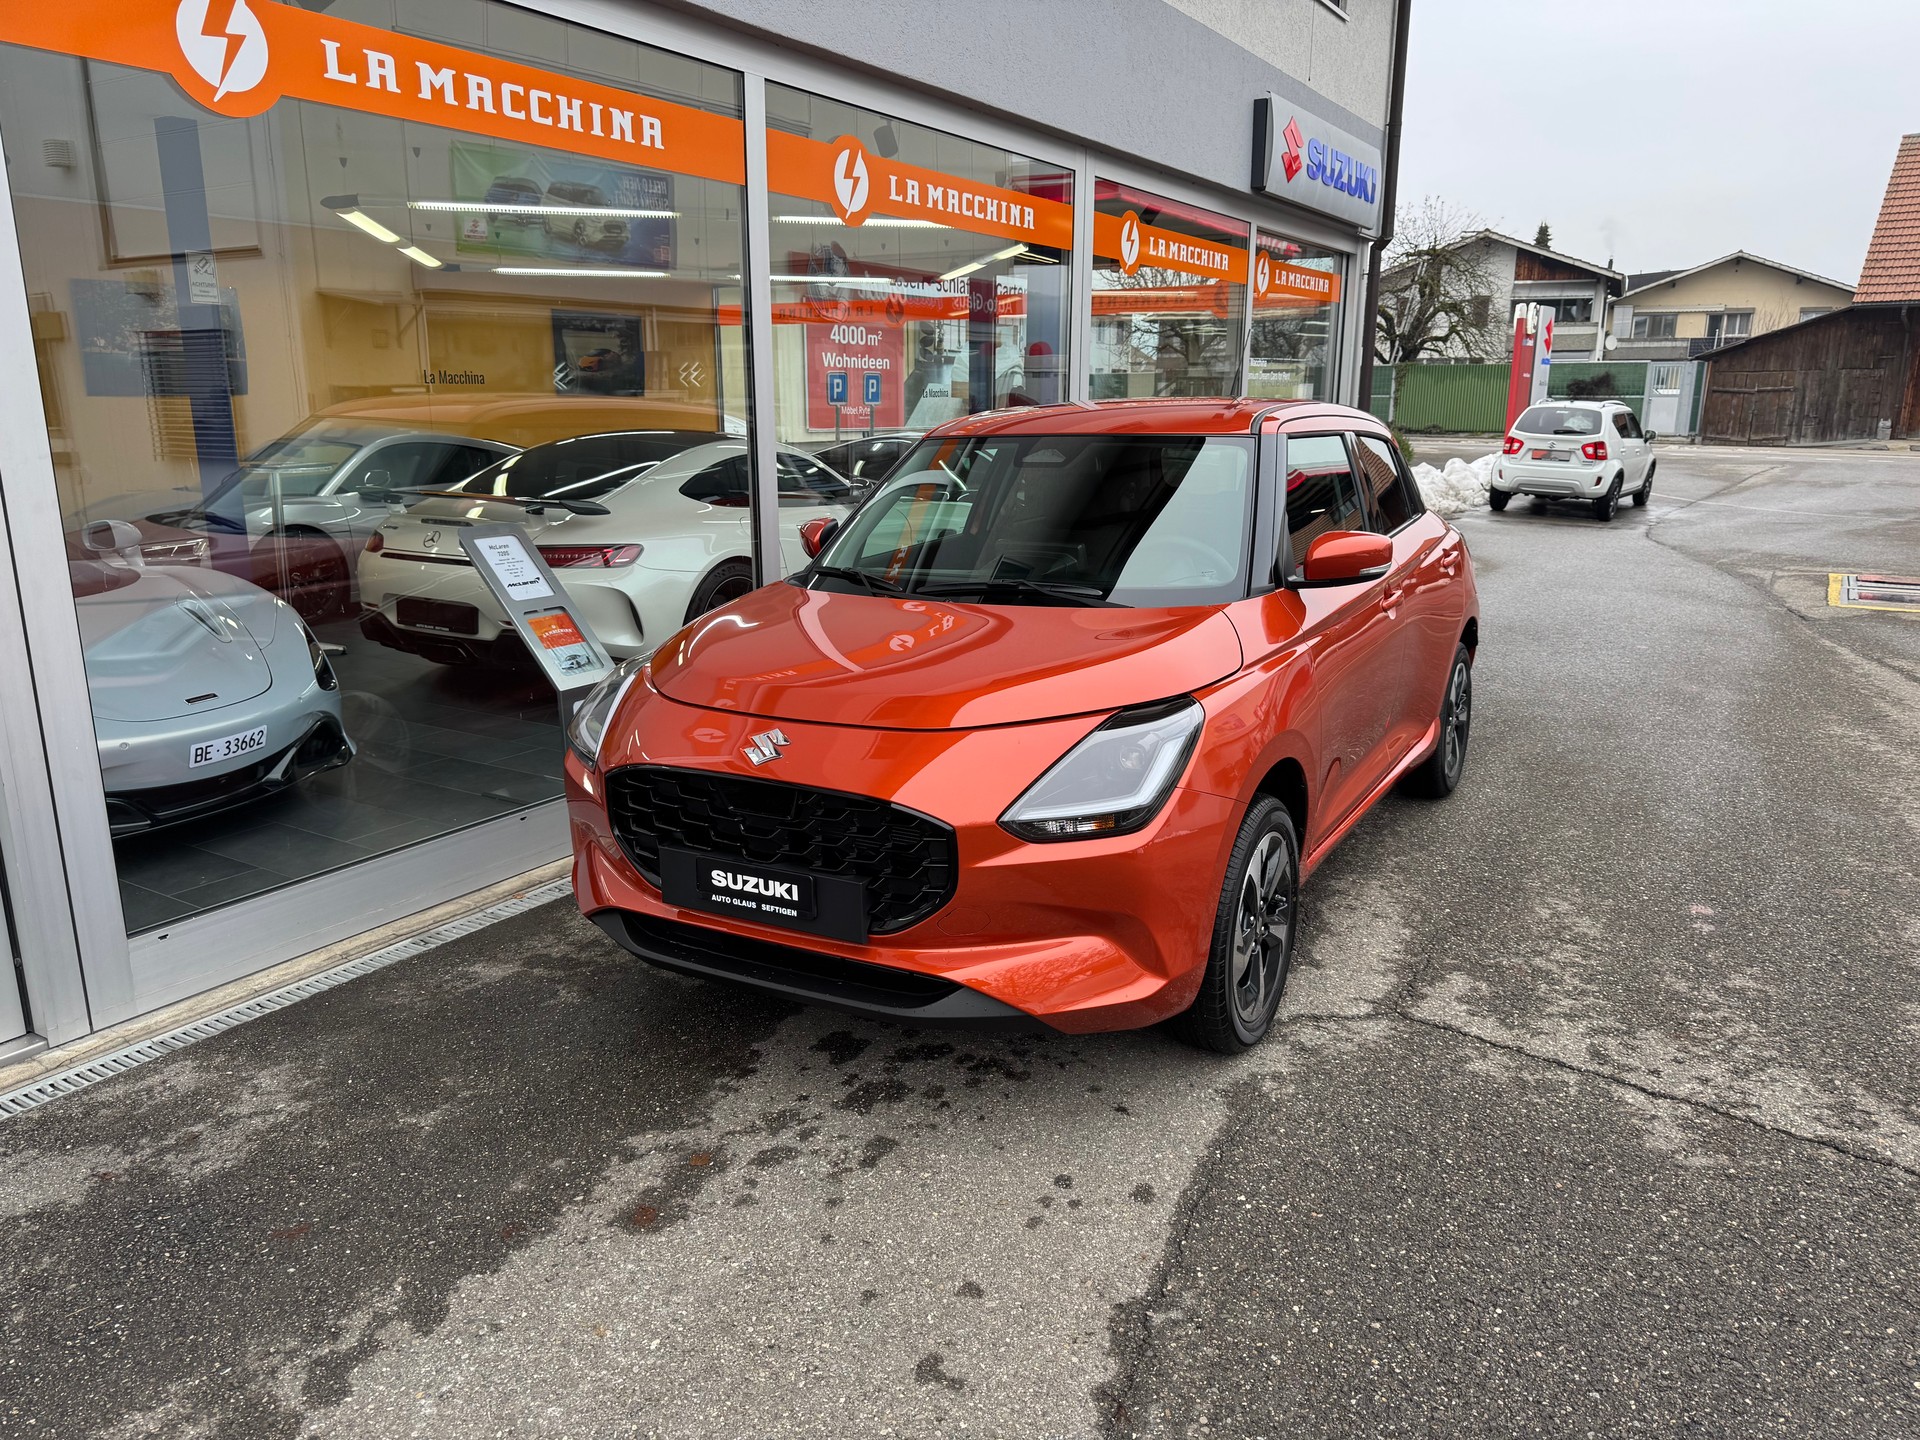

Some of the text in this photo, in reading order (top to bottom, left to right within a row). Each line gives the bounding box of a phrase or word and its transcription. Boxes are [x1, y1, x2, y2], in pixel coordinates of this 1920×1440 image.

[320, 39, 664, 149] LA MACCHINA
[1306, 138, 1376, 204] SUZUKI
[889, 175, 1034, 229] LA MACCHINA
[1149, 237, 1166, 257] LA
[1169, 241, 1228, 270] MACCHINA
[1275, 269, 1329, 293] LA MACCHINA
[822, 352, 890, 369] Wohnideen
[424, 370, 485, 384] La Macchina
[507, 579, 539, 588] McLaren
[194, 730, 264, 764] BE 33662
[711, 869, 799, 901] SUZUKI
[711, 894, 797, 917] AUTO GLAUS SEFTIGEN
